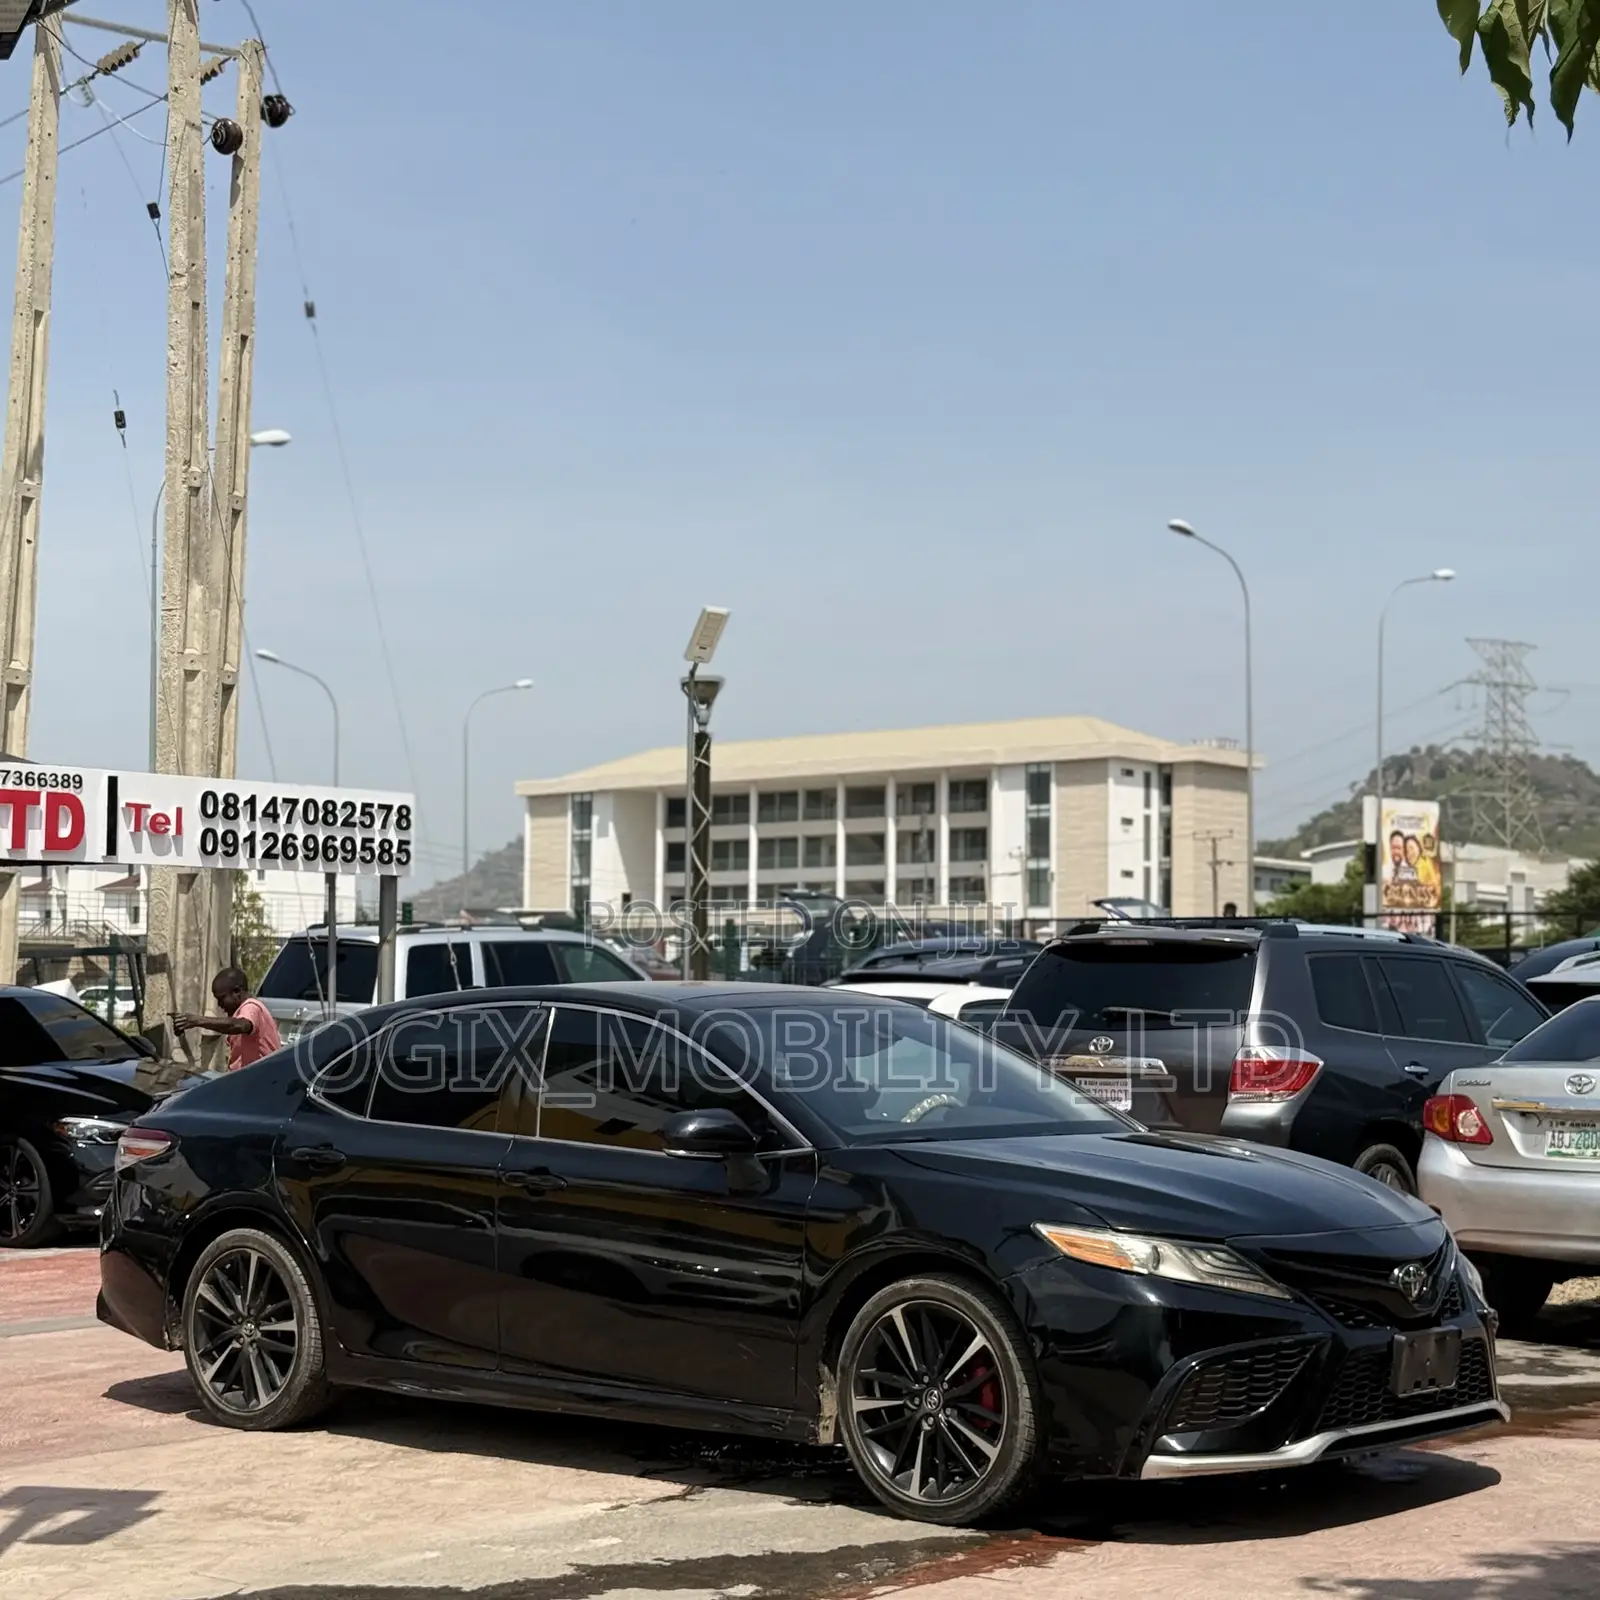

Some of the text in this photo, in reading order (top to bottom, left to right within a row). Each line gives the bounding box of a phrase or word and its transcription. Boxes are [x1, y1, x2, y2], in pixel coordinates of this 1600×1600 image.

[0, 770, 83, 790] 7366389
[0, 789, 86, 851] TD
[125, 802, 183, 836] Tel
[200, 790, 411, 831] 08147082578
[200, 827, 411, 866] 09126969585
